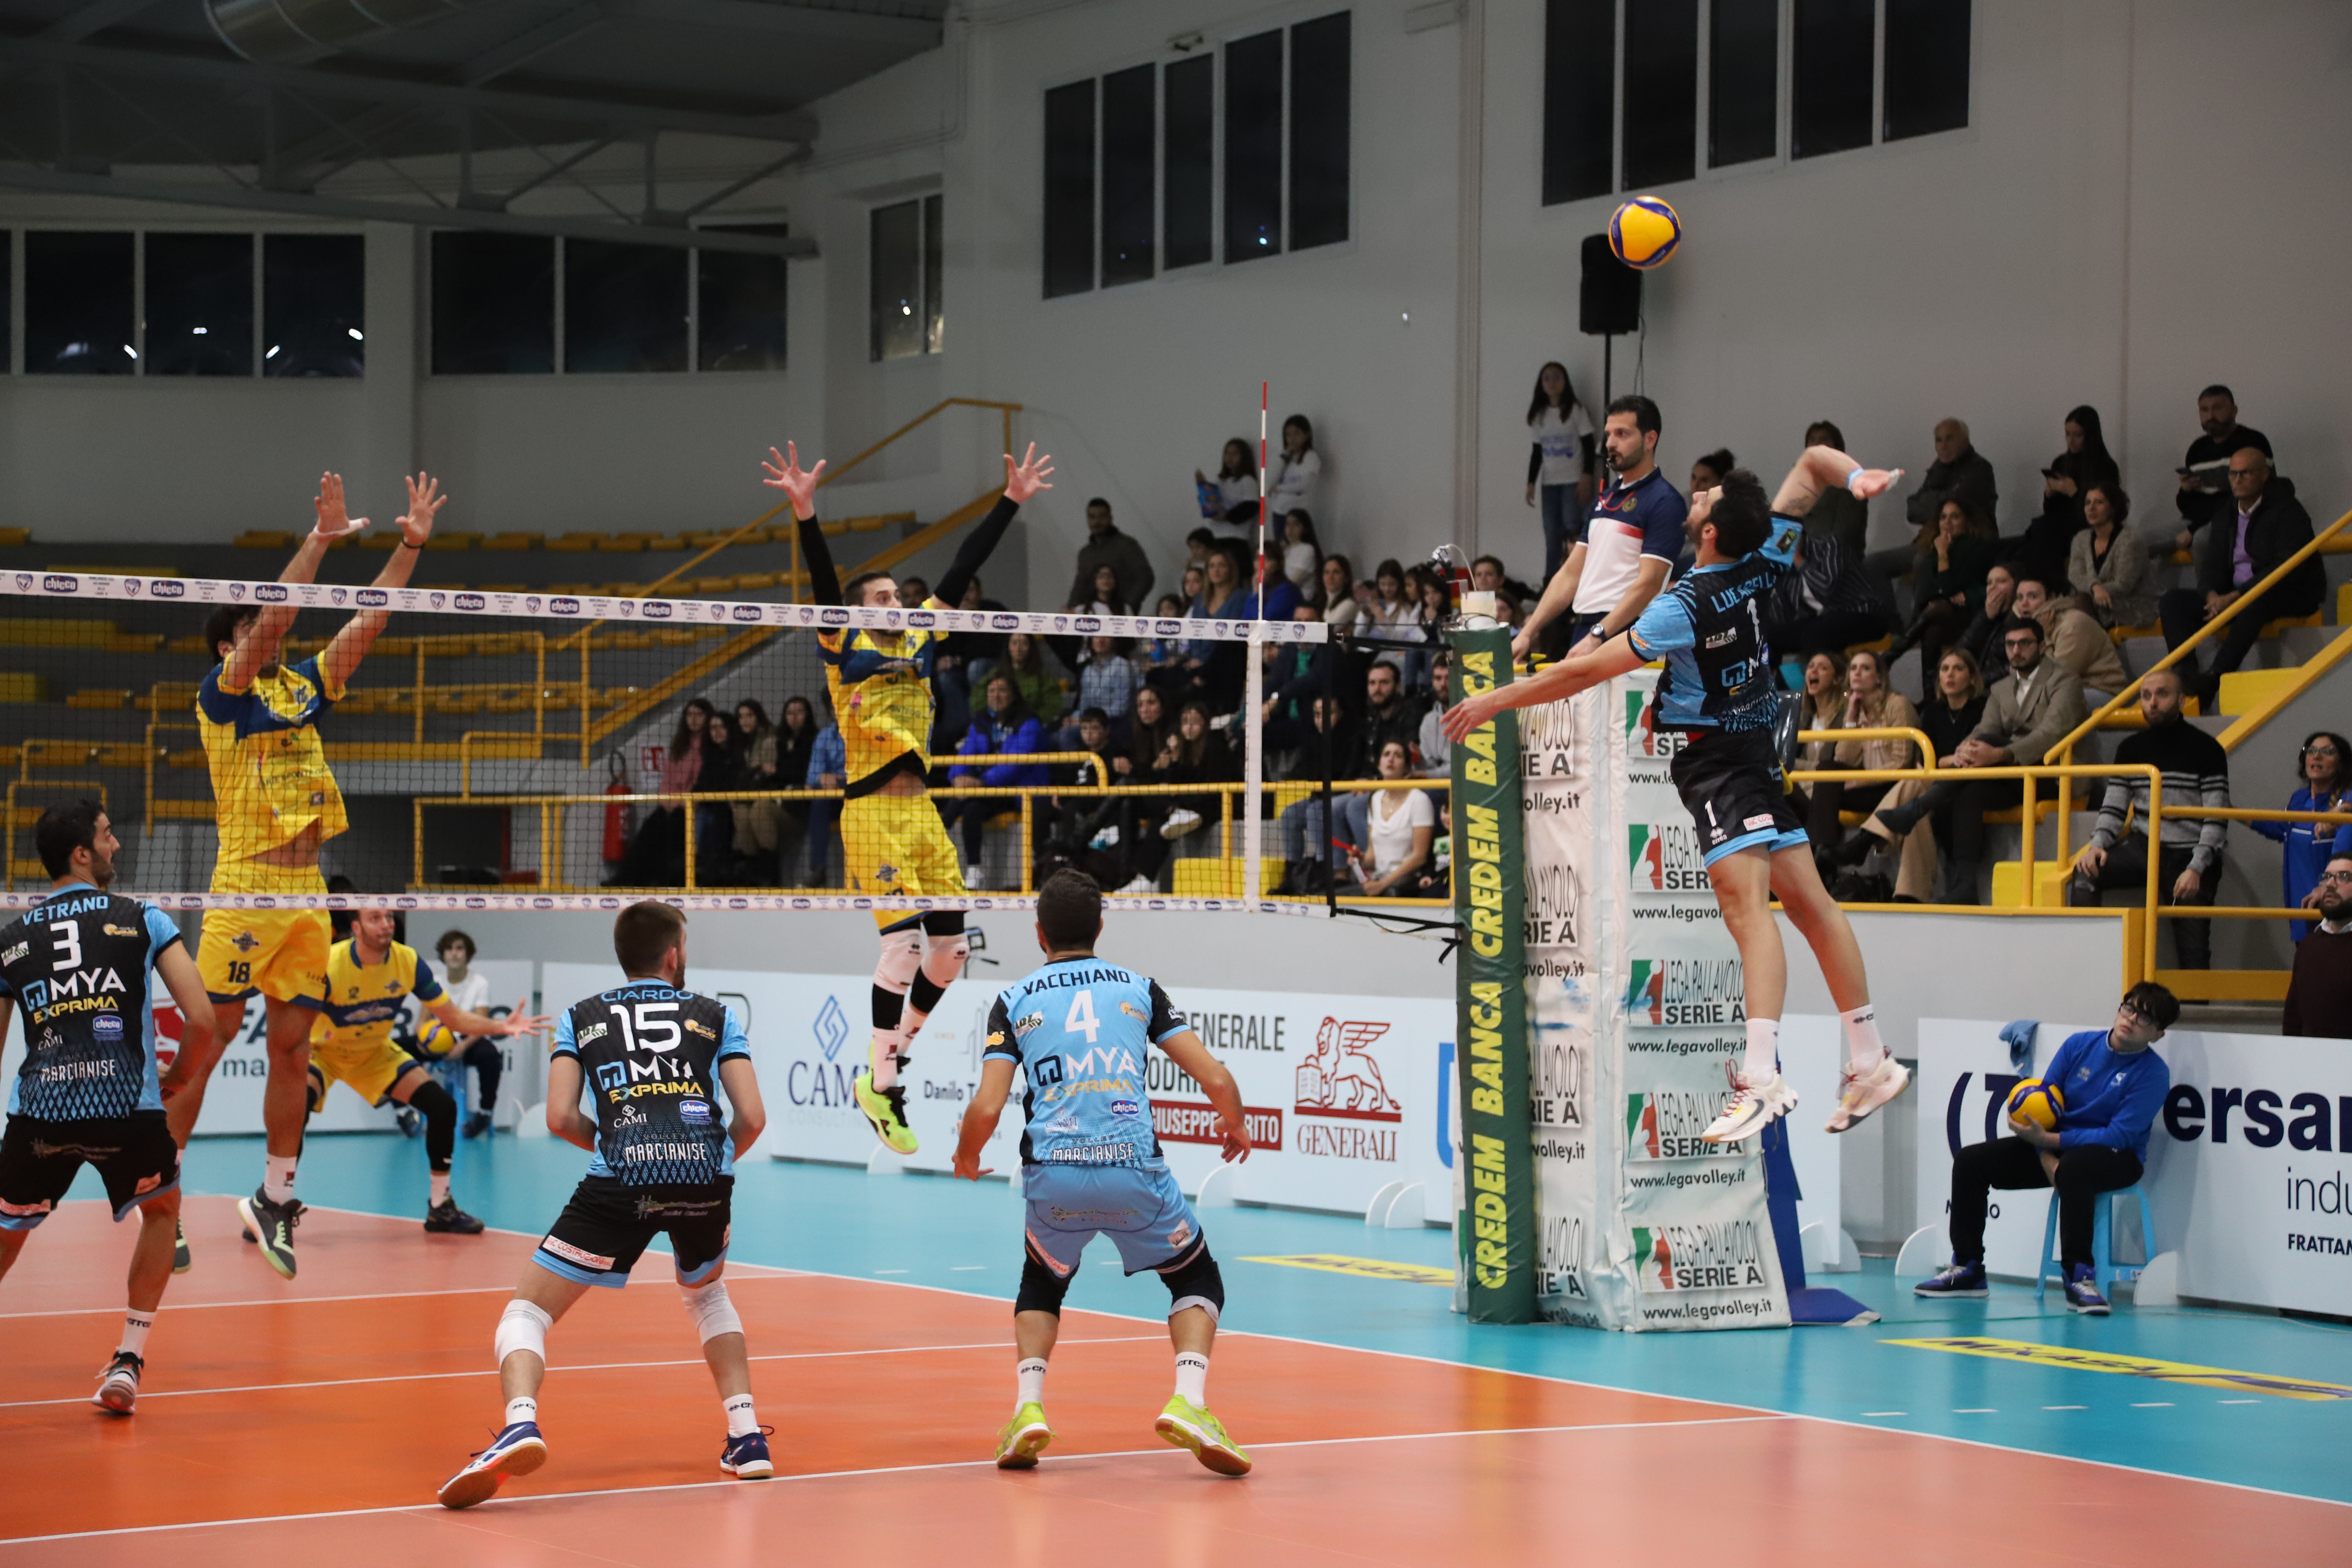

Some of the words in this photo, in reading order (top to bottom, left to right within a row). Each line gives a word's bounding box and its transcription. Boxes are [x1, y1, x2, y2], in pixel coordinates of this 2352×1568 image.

[45, 576, 76, 591] chicco
[152, 581, 183, 596] chicco
[257, 586, 286, 600] chicco
[358, 591, 386, 604] chicco
[456, 595, 483, 608] chicco
[551, 599, 578, 612] chicco
[644, 603, 670, 616] chicco
[1462, 651, 1497, 787] BACA
[1551, 754, 1571, 775] A
[1704, 800, 1717, 827] 1
[1661, 826, 1690, 868] LEGA
[1712, 834, 1727, 845] errea
[1466, 803, 1503, 958] CREDEM
[1666, 871, 1711, 890] SER
[22, 896, 109, 926] VETRANO
[1633, 905, 1721, 922] www.legavo
[1524, 921, 1552, 943] RIE
[1558, 921, 1576, 943] A
[50, 920, 82, 972] 3
[228, 961, 250, 983] 18
[1023, 969, 1130, 995] VACCHIANO
[1665, 961, 1690, 1004] LEGA
[50, 967, 126, 1001] MYA
[600, 989, 694, 1002] CIARDO
[34, 996, 118, 1024] EXPRIMA
[1065, 989, 1101, 1043] 4
[1666, 1004, 1724, 1024] SERIE
[1731, 1004, 1746, 1023] A
[96, 1017, 121, 1029] chicco
[610, 1003, 682, 1053] 15
[38, 1034, 63, 1051] CAMI
[1470, 983, 1504, 1116] BANCA
[1628, 1038, 1747, 1056] www.legavolley.it
[41, 1059, 116, 1082] MARCIANISE
[1066, 1047, 1138, 1079] MYA
[609, 1081, 704, 1103] EXPRIMA
[788, 1061, 869, 1109] CAM
[1044, 1078, 1133, 1101] EXPRIMA
[682, 1101, 708, 1113] chicco
[1113, 1101, 1138, 1112] chicco
[1562, 1101, 1581, 1124] A
[613, 1112, 648, 1128] CAMI
[1045, 1116, 1078, 1129] CAMI
[1223, 1114, 1280, 1143] RITO
[1072, 1135, 1115, 1144] VOLLEY
[1297, 1123, 1397, 1162] GENERALI
[1663, 1138, 1720, 1157] SERIE
[625, 1142, 707, 1164] MARCIANISE
[1052, 1143, 1134, 1161] MARCIANISE
[1631, 1168, 1746, 1189] www.legavolley.it
[1472, 1133, 1507, 1289] CREDEM
[1568, 1275, 1584, 1297] A
[1676, 1267, 1738, 1288] SERIE
[1747, 1267, 1764, 1284] A
[1643, 1298, 1772, 1320] www.legavolley.it
[1178, 1359, 1205, 1370] errea
